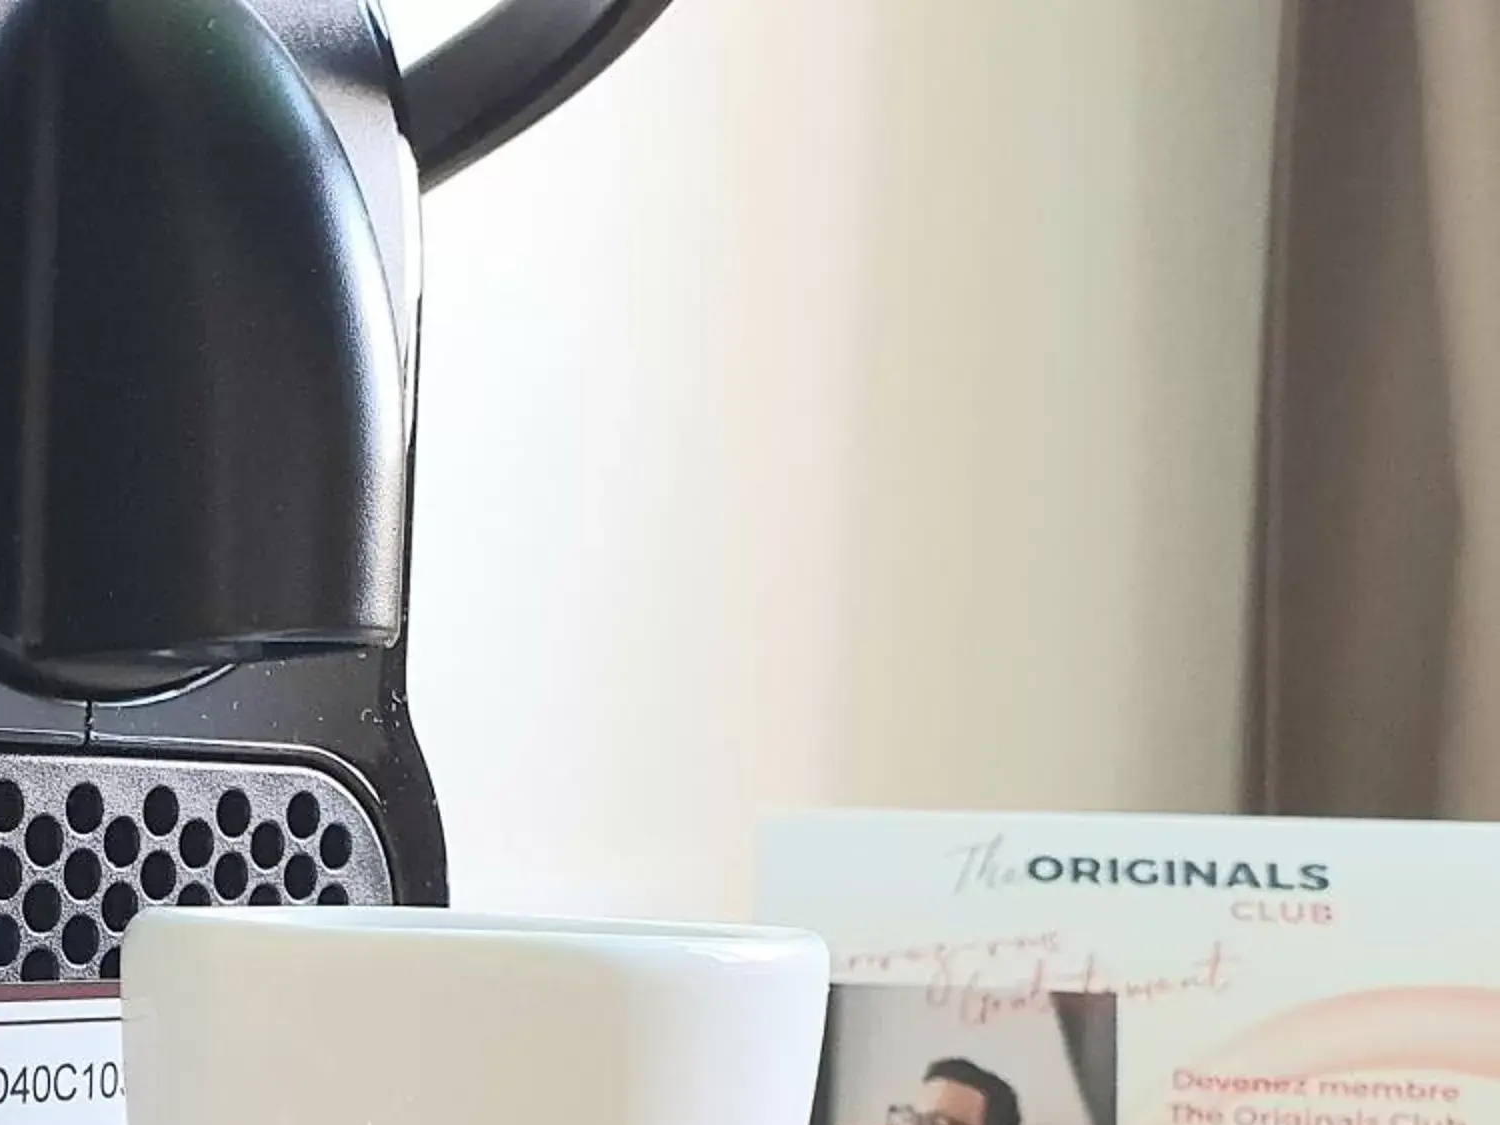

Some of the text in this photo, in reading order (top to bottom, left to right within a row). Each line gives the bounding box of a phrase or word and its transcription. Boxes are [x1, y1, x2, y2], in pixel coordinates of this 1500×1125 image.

[1027, 854, 1330, 892] ORIGINALS
[1229, 900, 1334, 924] CLUB
[1172, 1068, 1461, 1104] Devenez membre
